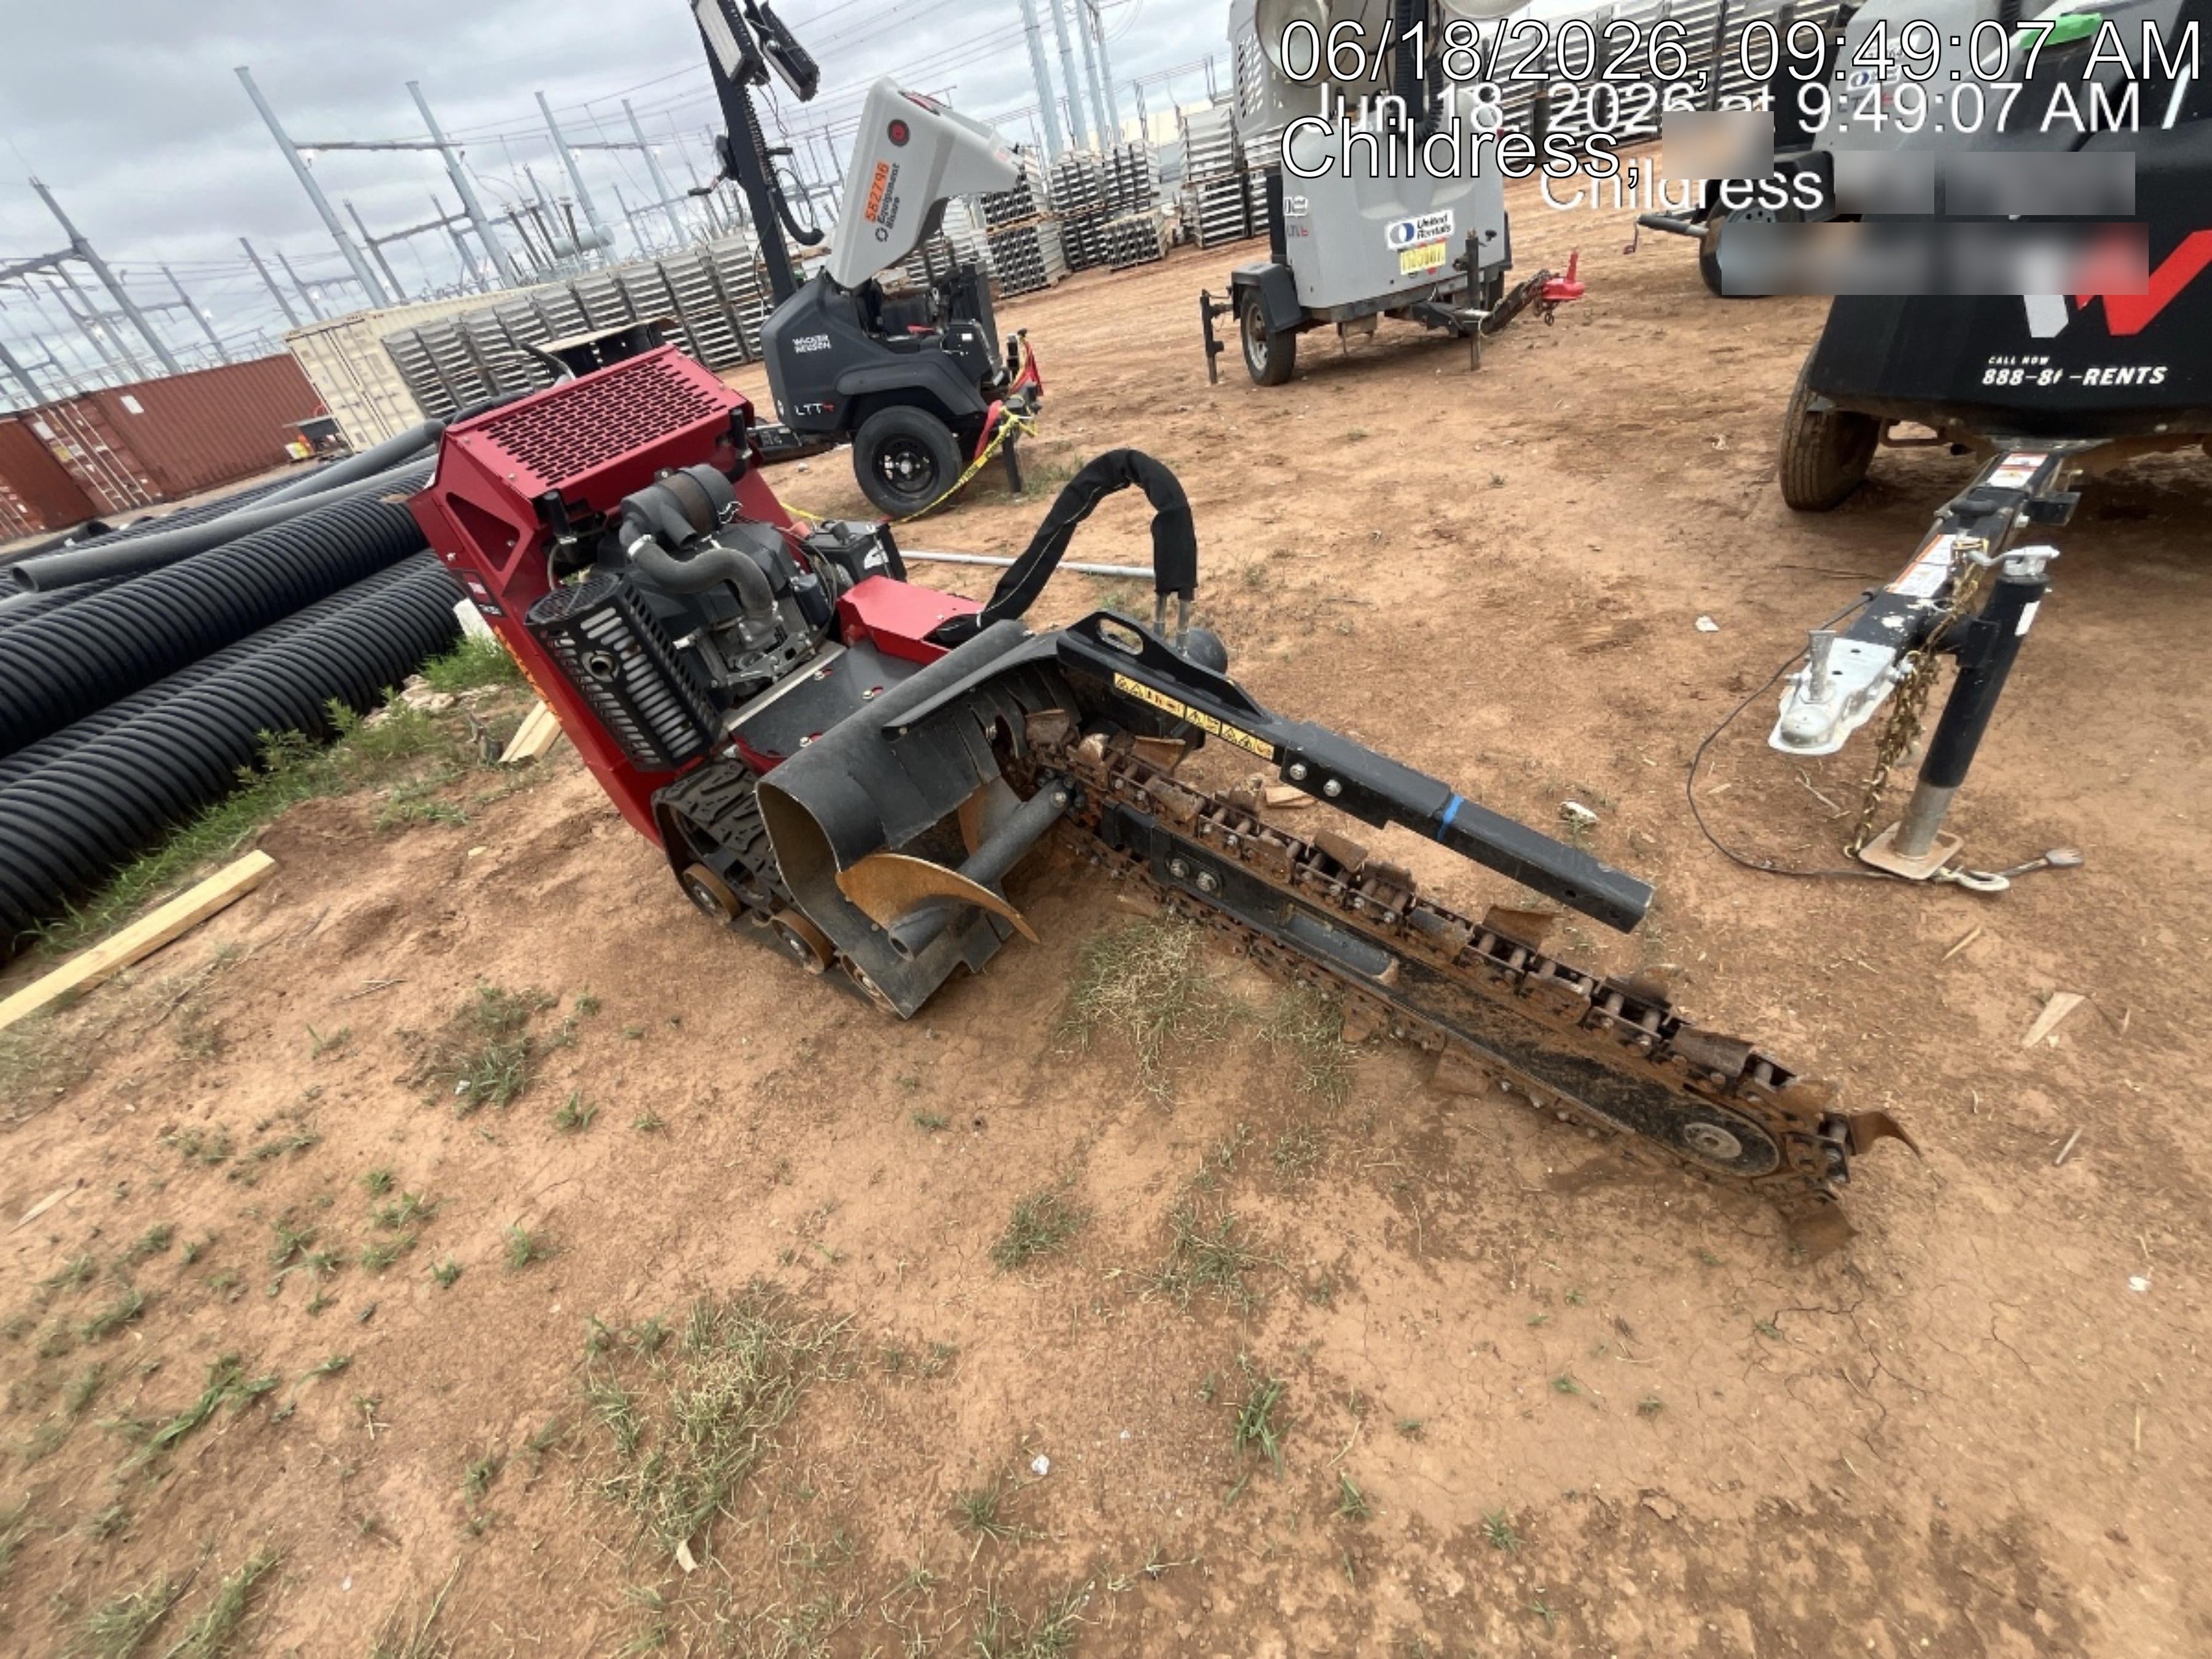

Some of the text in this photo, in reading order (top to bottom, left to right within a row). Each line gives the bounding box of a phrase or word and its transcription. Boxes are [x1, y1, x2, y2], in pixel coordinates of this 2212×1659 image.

[1417, 213, 1447, 229] United
[1417, 224, 1451, 240] Rentals
[1988, 356, 2050, 365] CALL NOW
